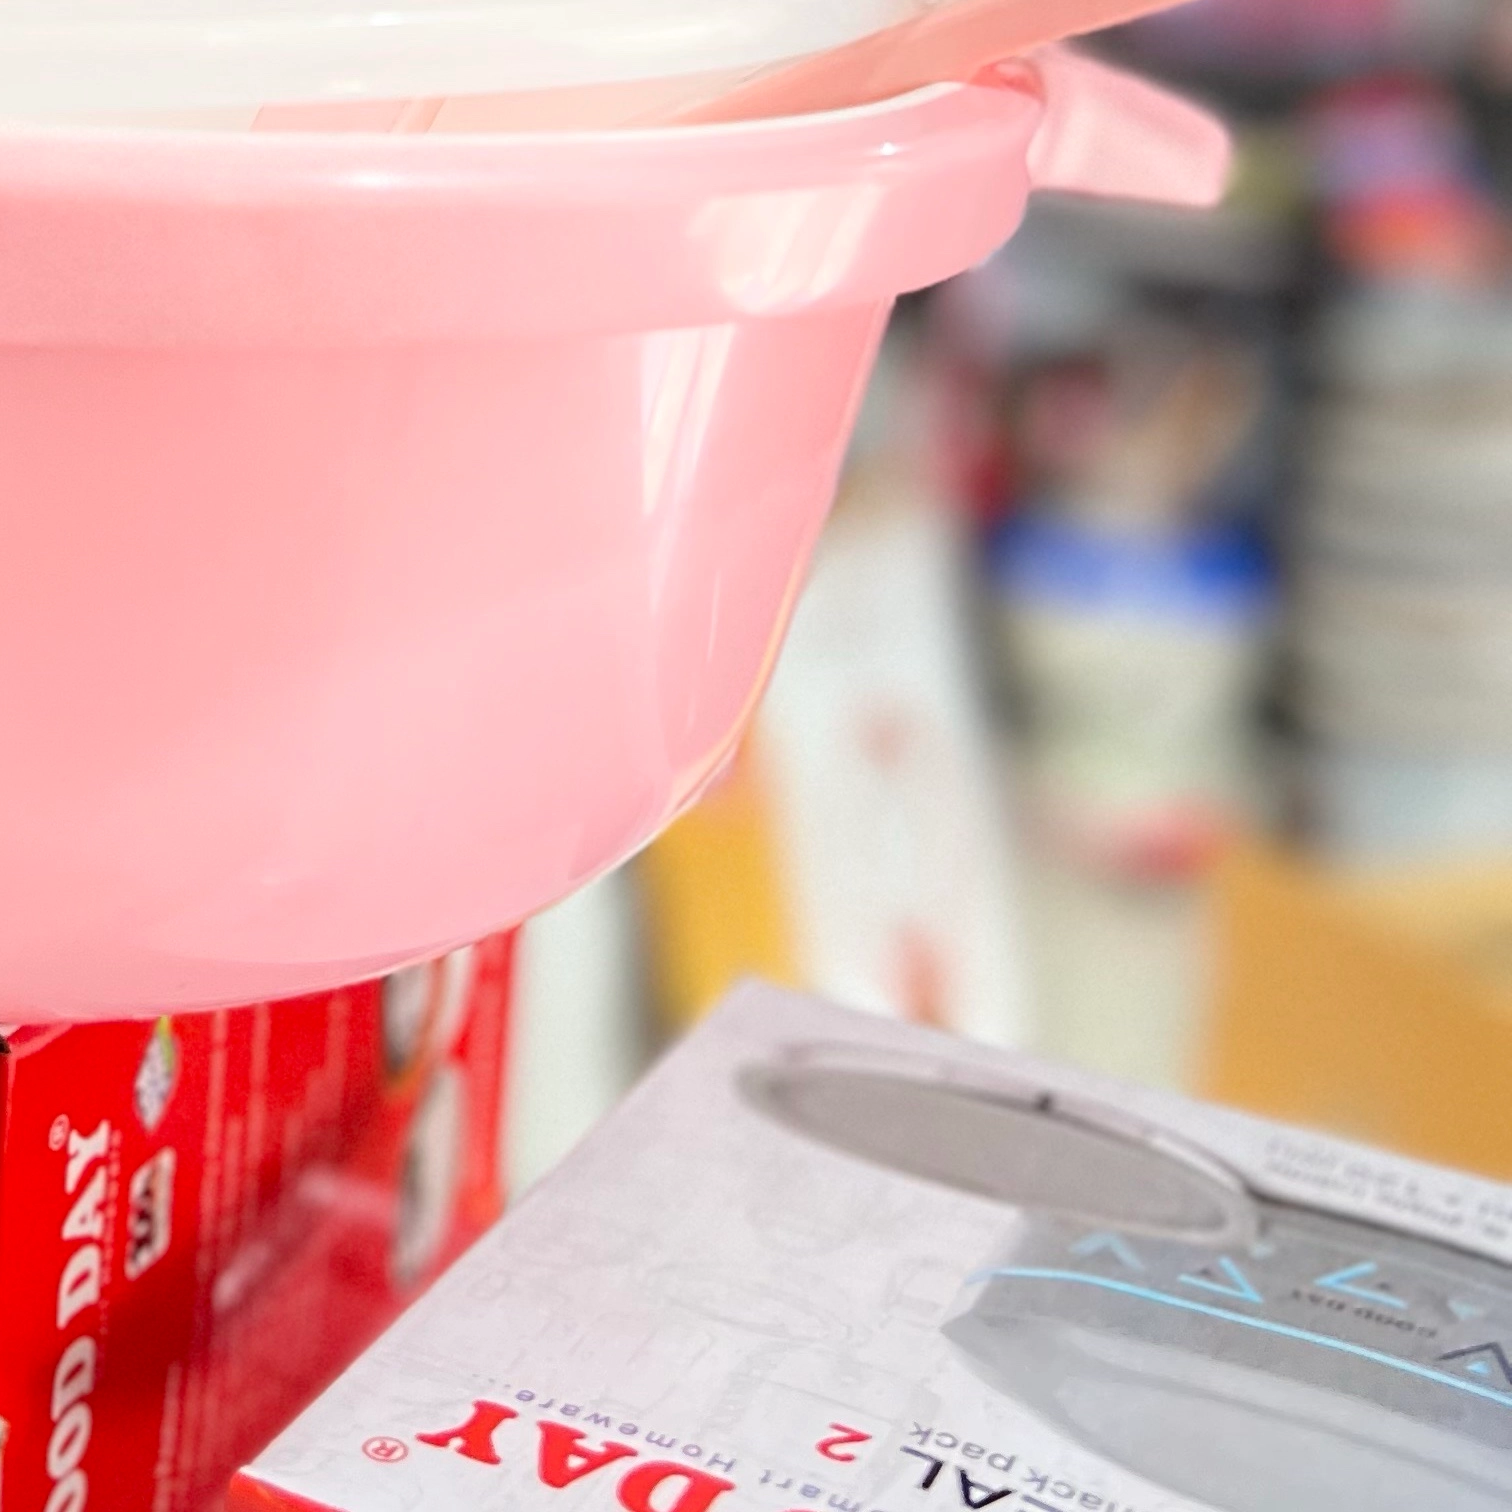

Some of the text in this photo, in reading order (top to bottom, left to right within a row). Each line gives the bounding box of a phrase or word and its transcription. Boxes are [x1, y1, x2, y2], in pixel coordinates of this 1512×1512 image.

[56, 1119, 111, 1330] DAY
[415, 1399, 737, 1512] DAY
[758, 1469, 886, 1512] mart
[815, 1421, 1065, 1512] AL 2
[908, 1421, 1017, 1472] pack
